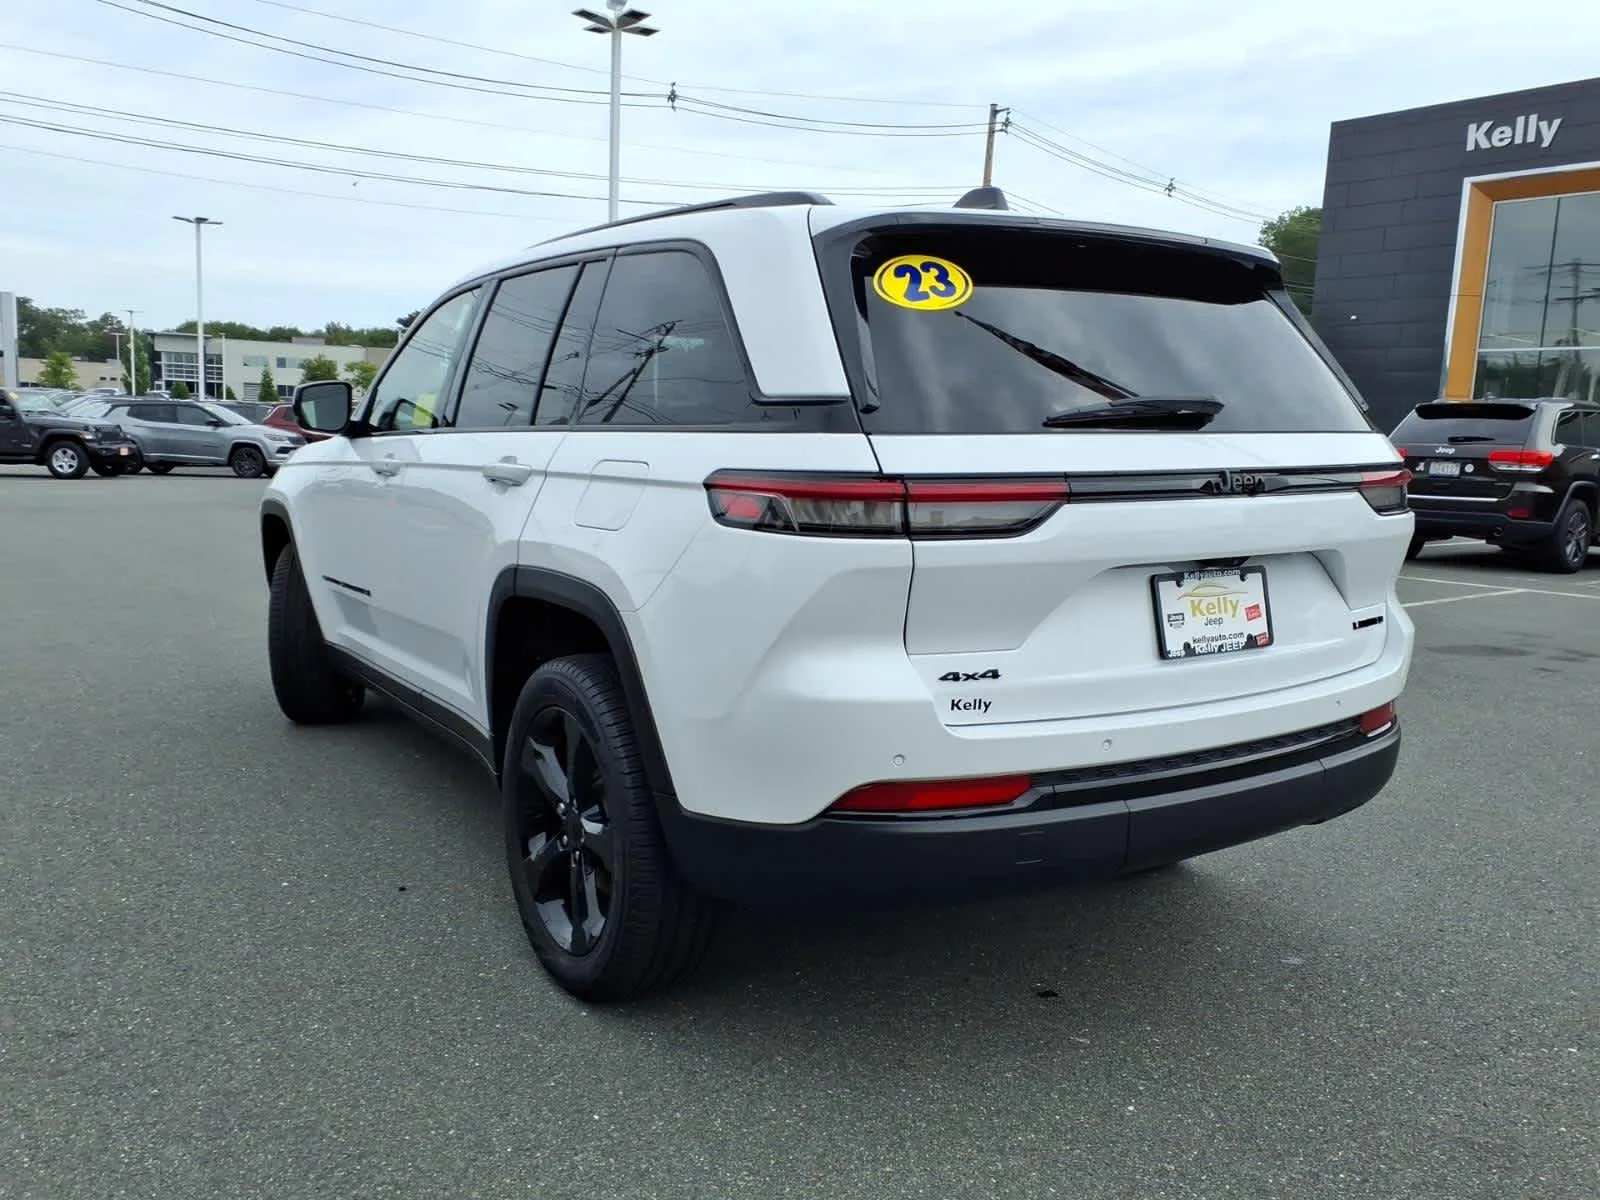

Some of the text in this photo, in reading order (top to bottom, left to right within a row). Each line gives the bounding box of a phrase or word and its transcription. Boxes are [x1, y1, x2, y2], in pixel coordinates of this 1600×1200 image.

[1466, 113, 1563, 152] Kelly
[893, 261, 957, 302] 23
[1184, 569, 1241, 581] Kellyauto.com
[1190, 597, 1240, 618] Kelly
[1204, 617, 1224, 626] Jeep
[1192, 632, 1244, 644] kellyauto.com
[1221, 641, 1246, 651] JEEP
[938, 669, 1001, 682] 4x4
[951, 698, 993, 713] Kelly
